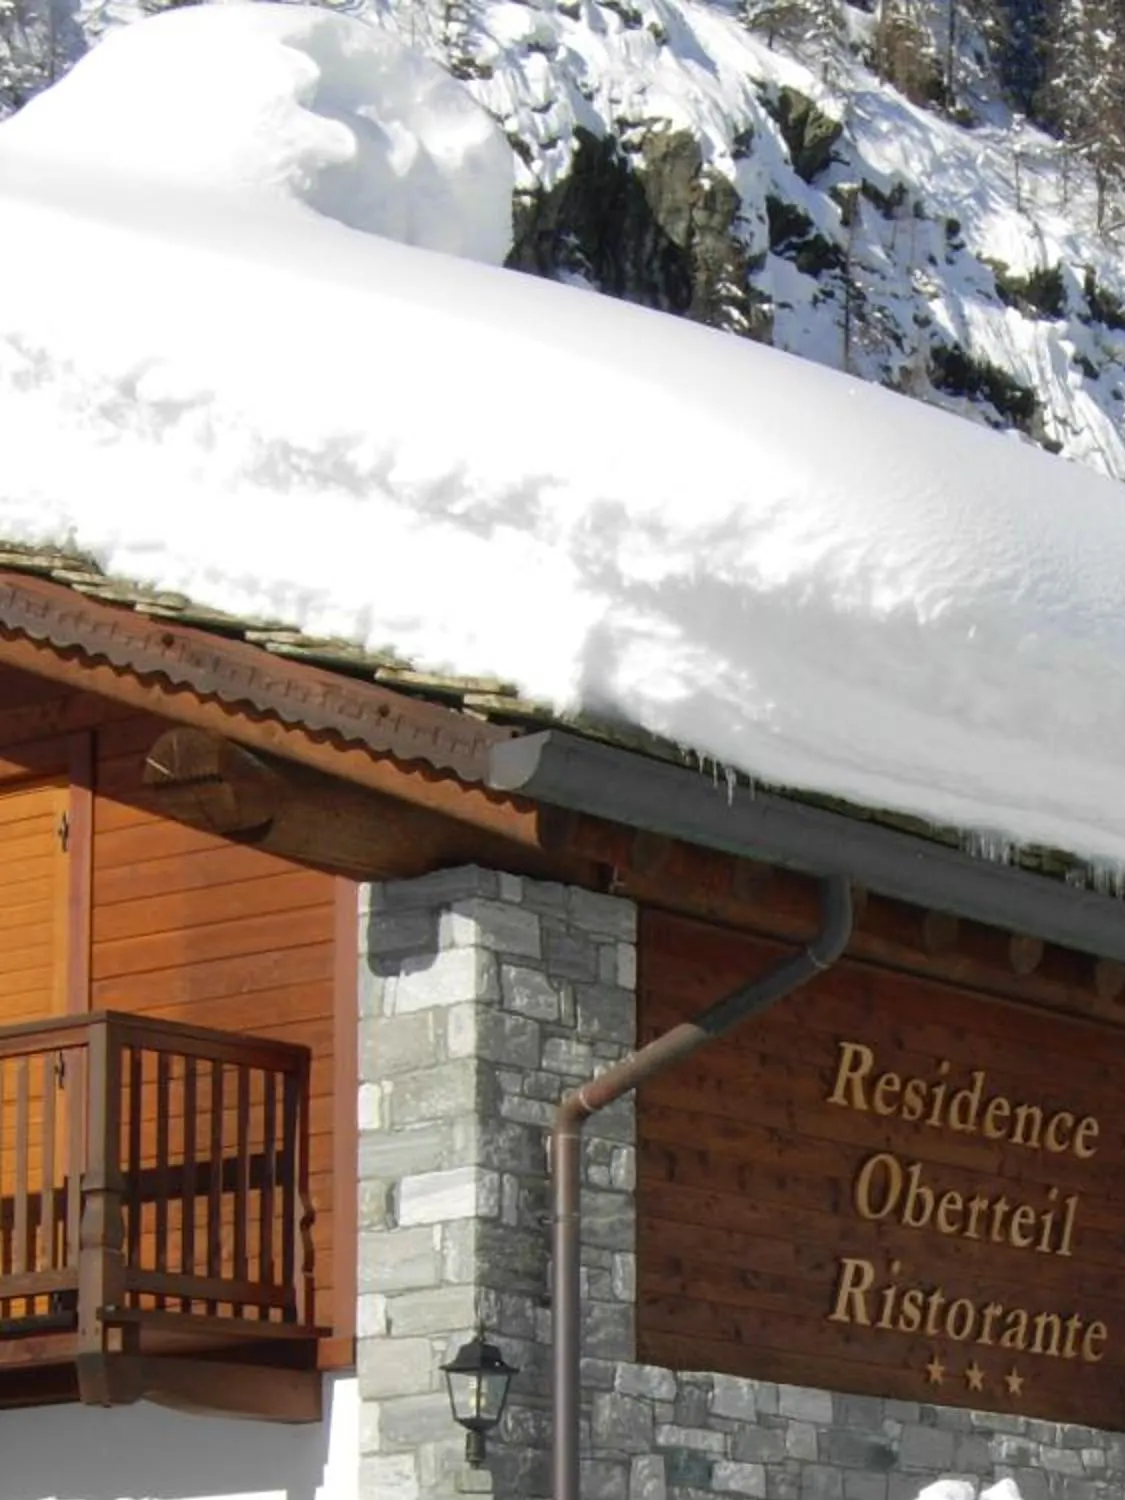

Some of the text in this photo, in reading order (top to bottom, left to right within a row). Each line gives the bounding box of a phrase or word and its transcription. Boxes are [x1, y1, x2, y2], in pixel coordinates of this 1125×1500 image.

[827, 1041, 1100, 1159] Residence
[856, 1153, 1079, 1257] Oberteil
[828, 1257, 1108, 1362] Ristorante
